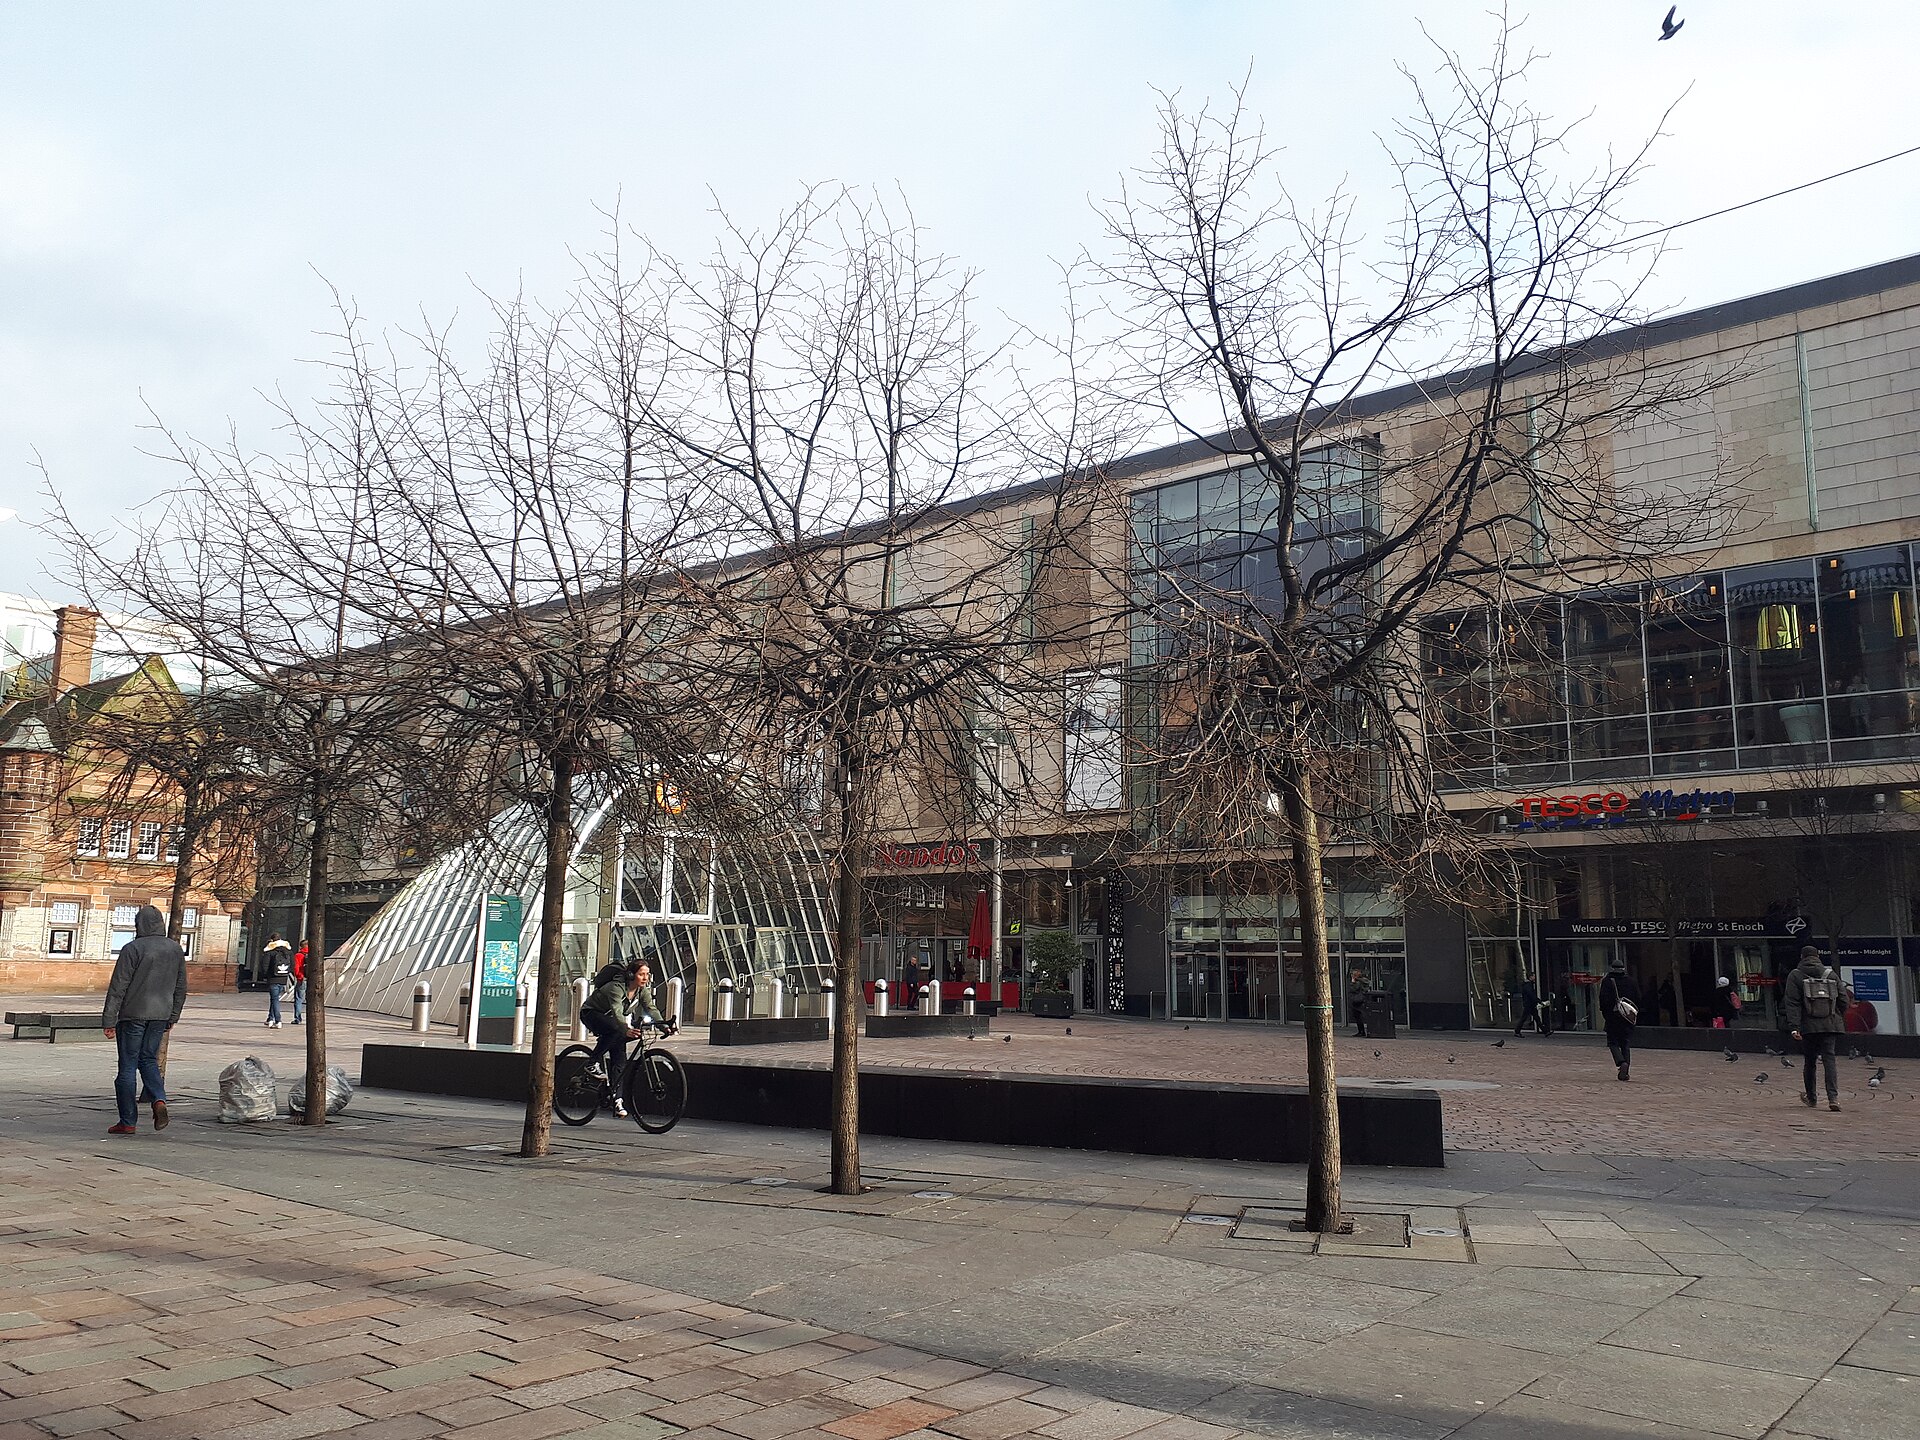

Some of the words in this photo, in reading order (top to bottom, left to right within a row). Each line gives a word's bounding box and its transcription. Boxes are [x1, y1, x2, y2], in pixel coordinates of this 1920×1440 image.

[1516, 792, 1629, 818] TESCO
[1640, 788, 1735, 813] Metro
[1572, 924, 1614, 933] Welcome
[1631, 921, 1667, 930] TESC
[1717, 922, 1729, 931] St
[1731, 922, 1764, 931] Enoch
